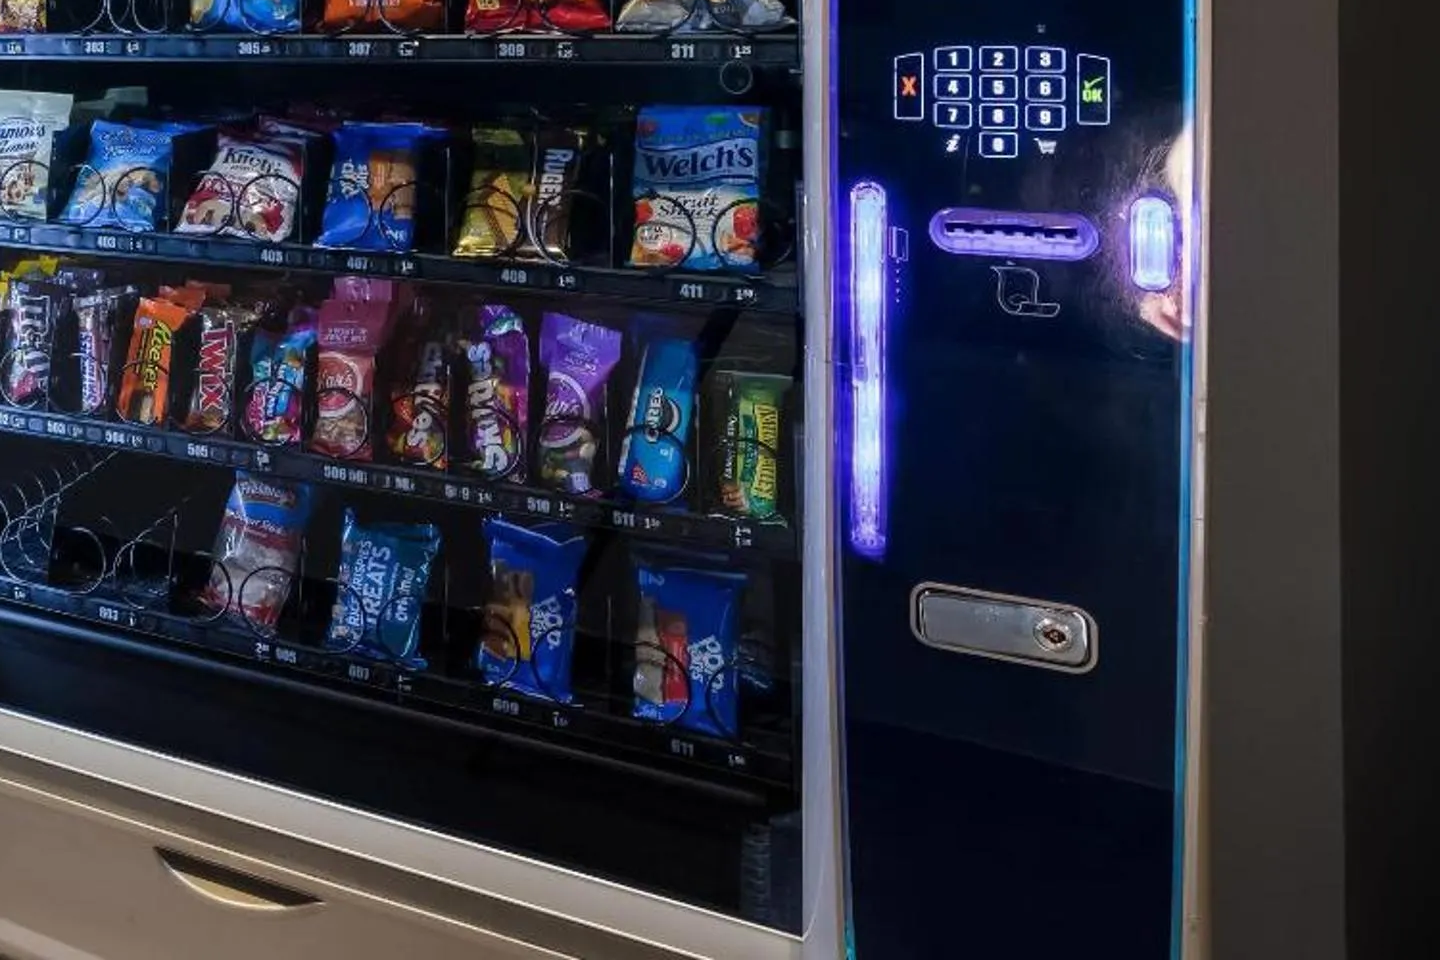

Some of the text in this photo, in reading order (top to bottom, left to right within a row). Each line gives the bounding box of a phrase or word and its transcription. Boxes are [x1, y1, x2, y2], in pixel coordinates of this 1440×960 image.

[498, 43, 525, 58] 309
[671, 43, 695, 59] 311
[948, 52, 958, 66] 1
[993, 52, 1004, 66] 2
[1039, 52, 1051, 67] 3
[947, 80, 959, 94] 4
[993, 80, 1004, 95] 5
[1039, 81, 1051, 96] 6
[1082, 88, 1103, 103] OK
[947, 108, 958, 123] 7
[993, 108, 1004, 124] 8
[1039, 110, 1051, 125] 9
[993, 137, 1004, 153] 0
[643, 146, 754, 178] Welch's
[680, 283, 704, 298] 411
[362, 546, 392, 624] TREATS
